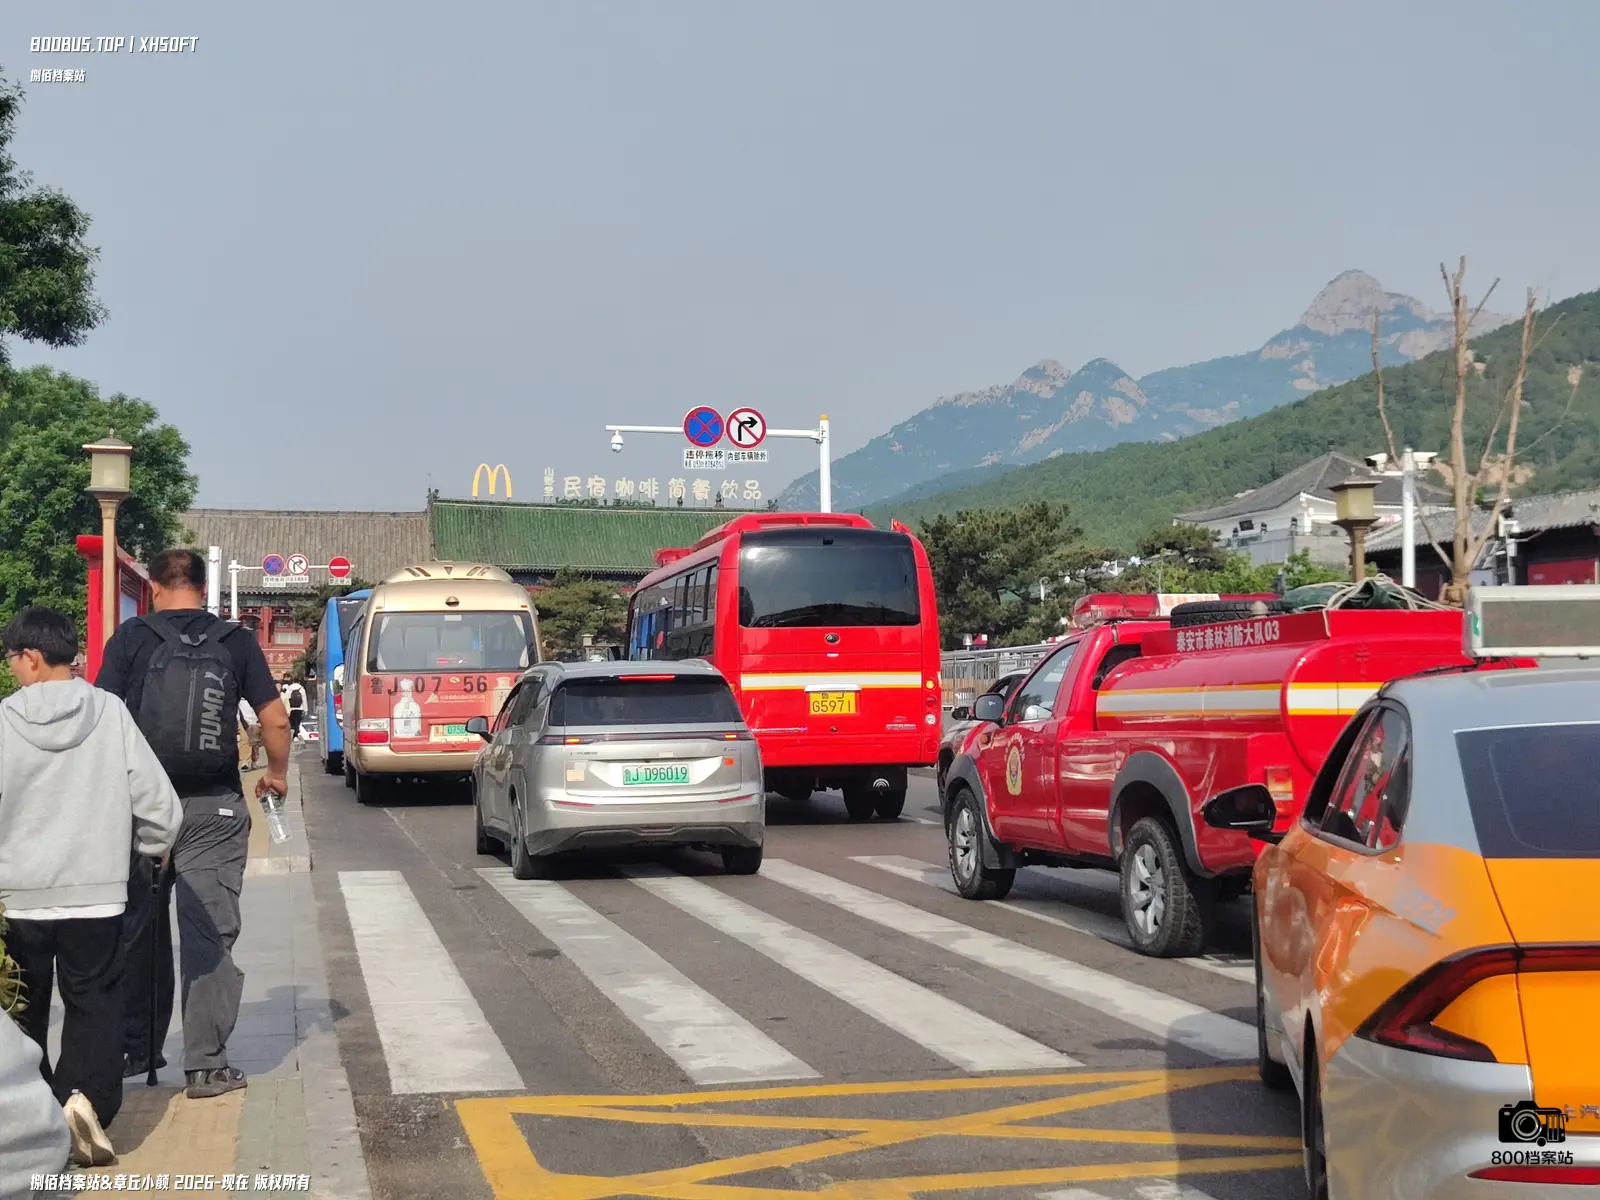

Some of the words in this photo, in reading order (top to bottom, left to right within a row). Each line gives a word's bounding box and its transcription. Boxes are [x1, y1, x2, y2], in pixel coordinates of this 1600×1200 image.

[1177, 620, 1280, 653] 泰安市森林消防大队03
[200, 686, 225, 750] PUMA
[812, 700, 851, 712] G5971
